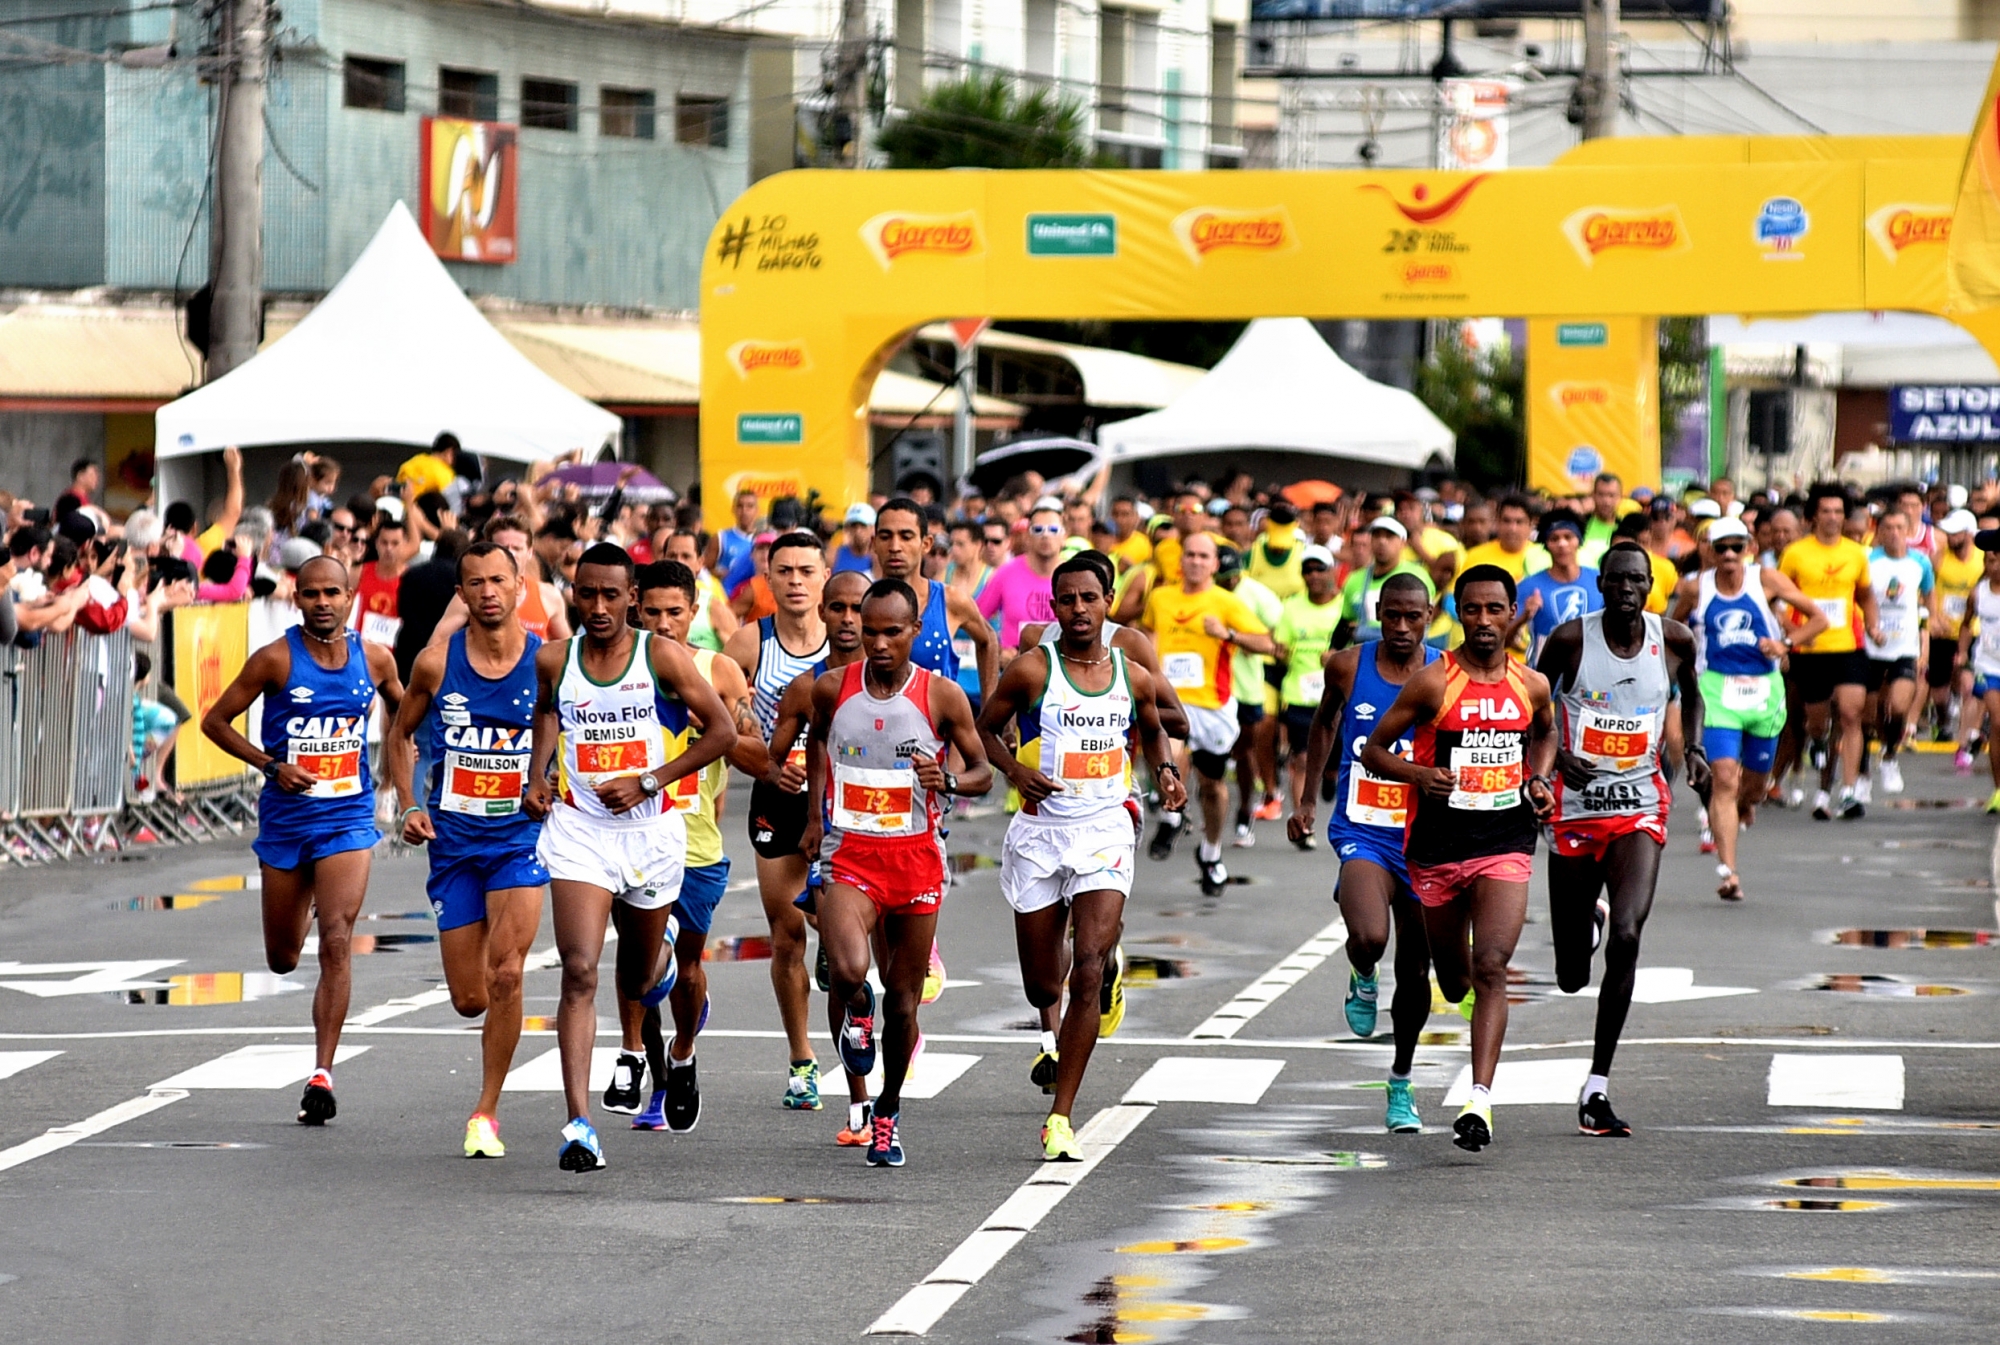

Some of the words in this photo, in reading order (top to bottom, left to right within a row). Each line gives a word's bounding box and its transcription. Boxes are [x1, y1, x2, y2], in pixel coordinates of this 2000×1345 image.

[880, 217, 973, 258] Garoto
[1191, 213, 1283, 253] Garoto
[1582, 213, 1677, 253] Garoto
[740, 343, 801, 370] Garoto
[1908, 413, 2000, 440] AZUL
[575, 709, 617, 724] Nova
[621, 706, 654, 721] Flor
[1460, 698, 1520, 721] FILA
[286, 715, 365, 739] CAIXA
[1063, 713, 1105, 727] Nova
[1593, 717, 1642, 731] KIPROP
[444, 726, 533, 751] CAIXA
[584, 726, 636, 741] DEMISU
[1461, 727, 1521, 747] bioleve
[299, 740, 360, 753] GILBERTO
[1081, 737, 1115, 751] EBISA
[1603, 735, 1630, 755] 65
[318, 757, 343, 777] 57
[458, 755, 521, 770] EDMILSON
[597, 746, 624, 769] 67
[472, 775, 502, 796] 52
[1483, 768, 1506, 790] 66
[863, 789, 891, 812] 72
[1377, 787, 1403, 807] 53
[1583, 799, 1642, 811] SPORTS
[756, 830, 773, 842] NB
